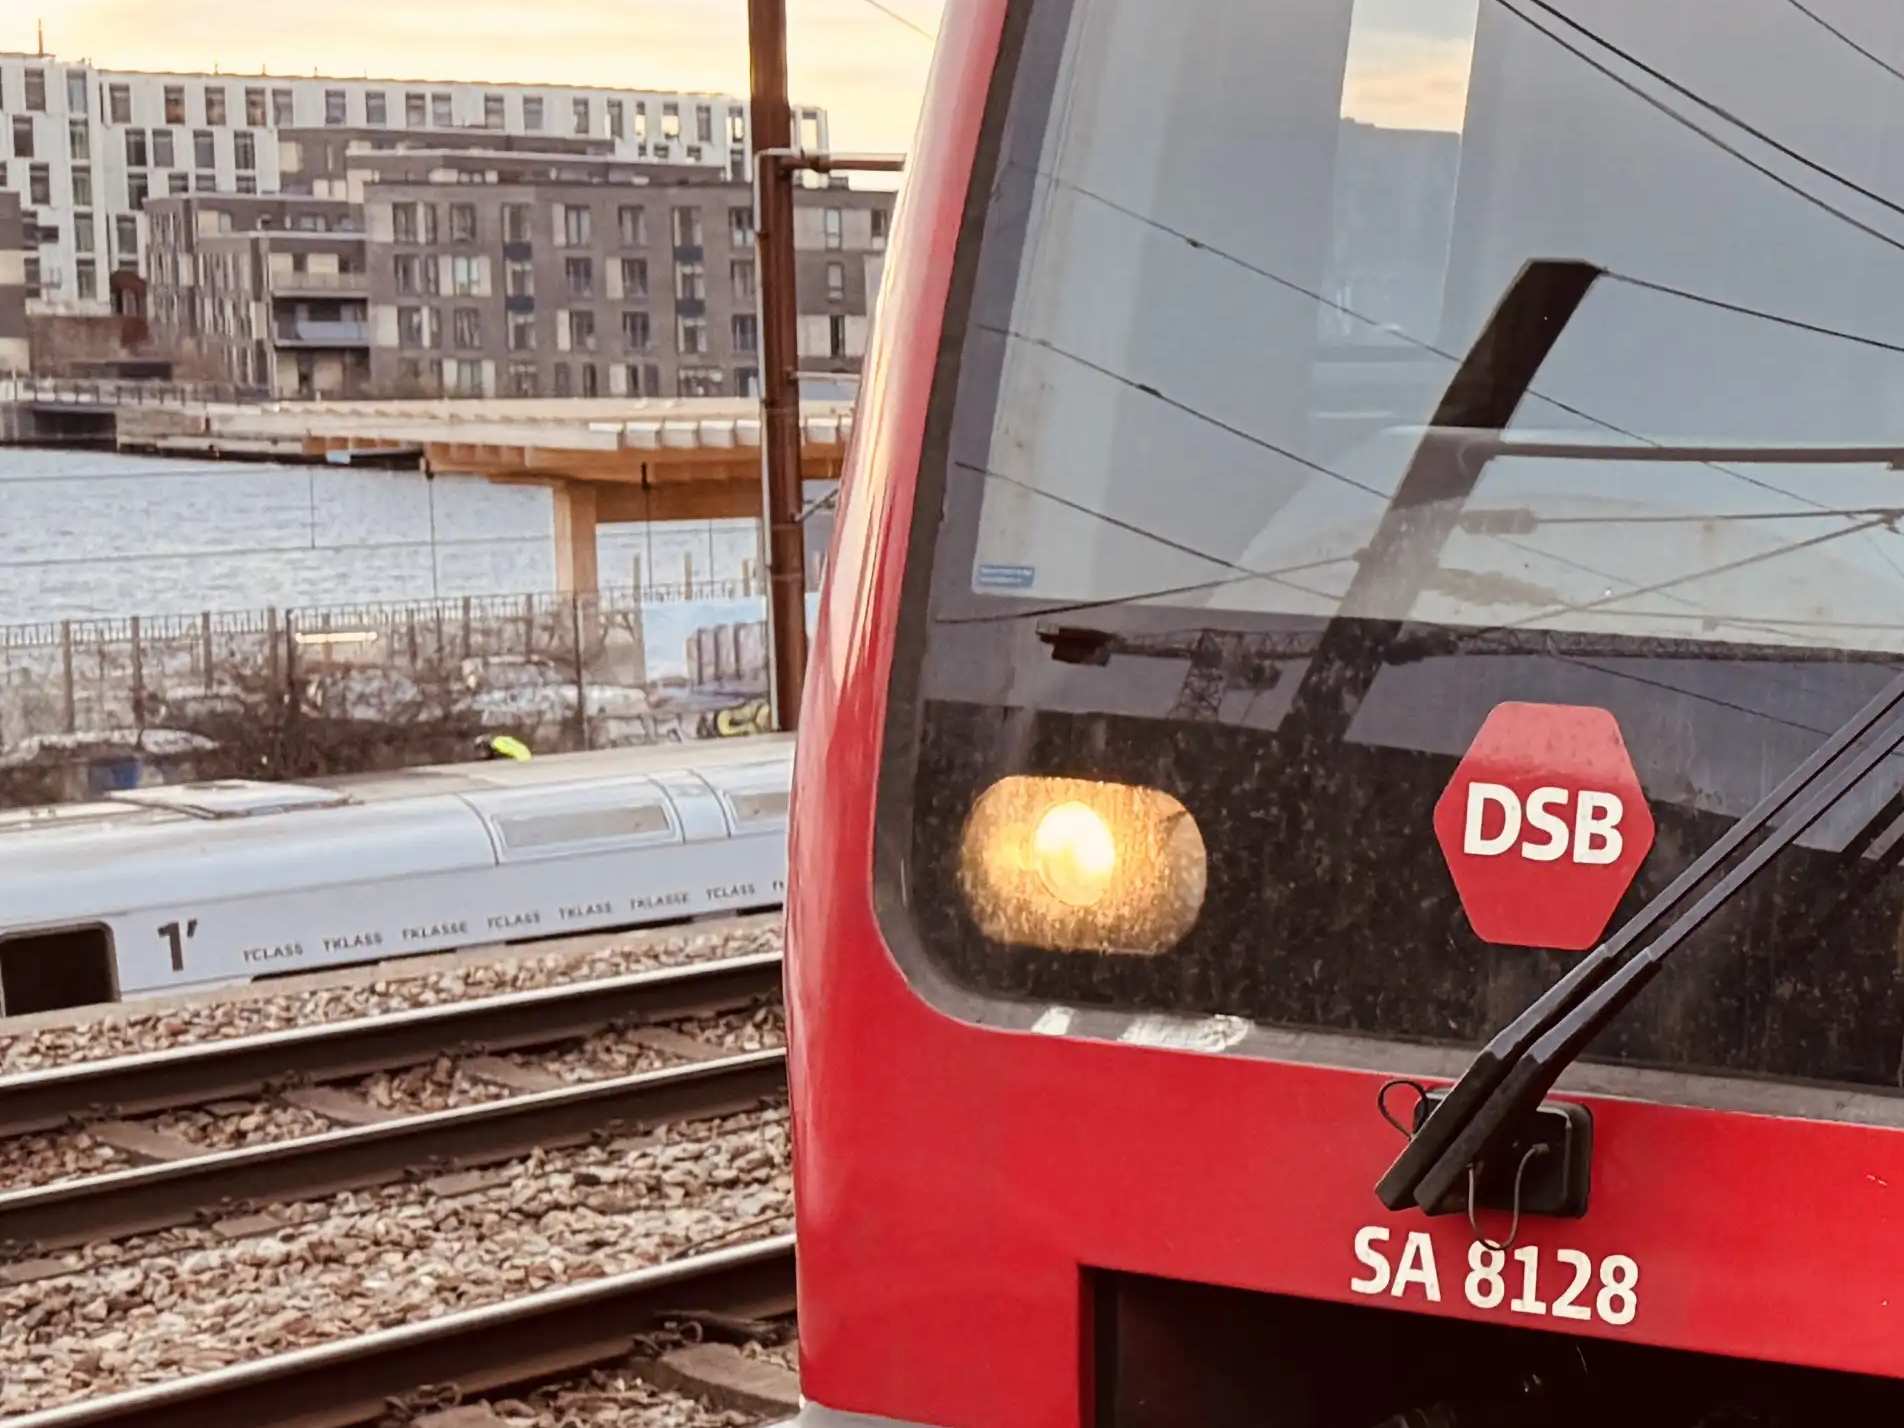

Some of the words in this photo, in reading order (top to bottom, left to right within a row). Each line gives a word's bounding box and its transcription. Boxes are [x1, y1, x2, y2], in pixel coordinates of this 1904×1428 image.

[1463, 781, 1624, 867] DSB
[1350, 1225, 1442, 1303] SA
[1464, 1241, 1639, 1326] 8128
